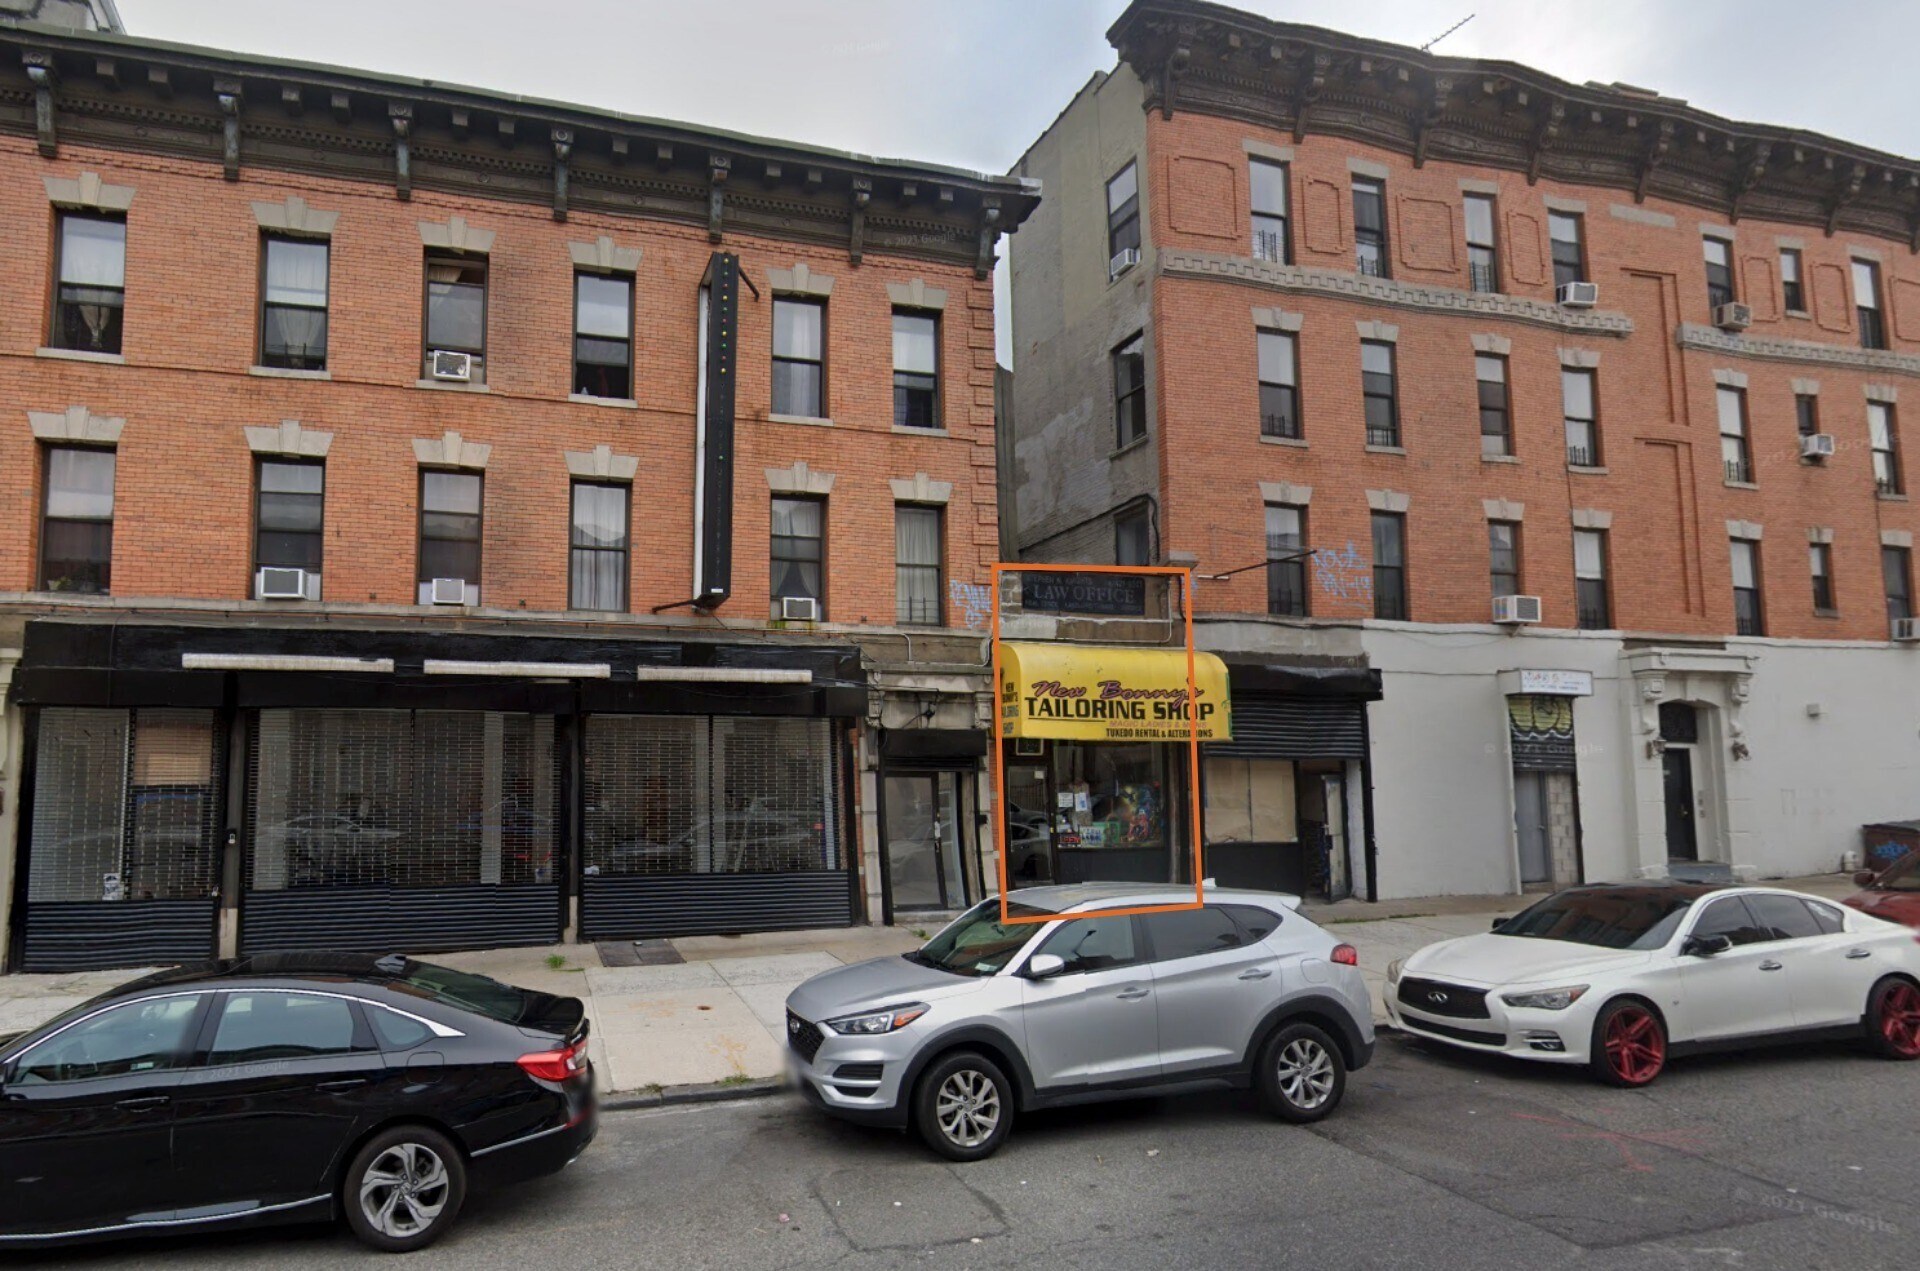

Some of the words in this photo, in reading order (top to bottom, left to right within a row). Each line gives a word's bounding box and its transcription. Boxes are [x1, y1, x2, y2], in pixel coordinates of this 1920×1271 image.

[1034, 584, 1069, 600] LAW
[1073, 586, 1135, 604] OFFICE
[1032, 680, 1086, 698] New
[1025, 697, 1145, 720] TAILORING
[1153, 701, 1214, 721] SHOP
[1109, 720, 1139, 728] MAGIC
[1182, 721, 1207, 729] MNS
[1134, 728, 1160, 738] RENTAL
[1168, 728, 1213, 739] ALTERAIONS
